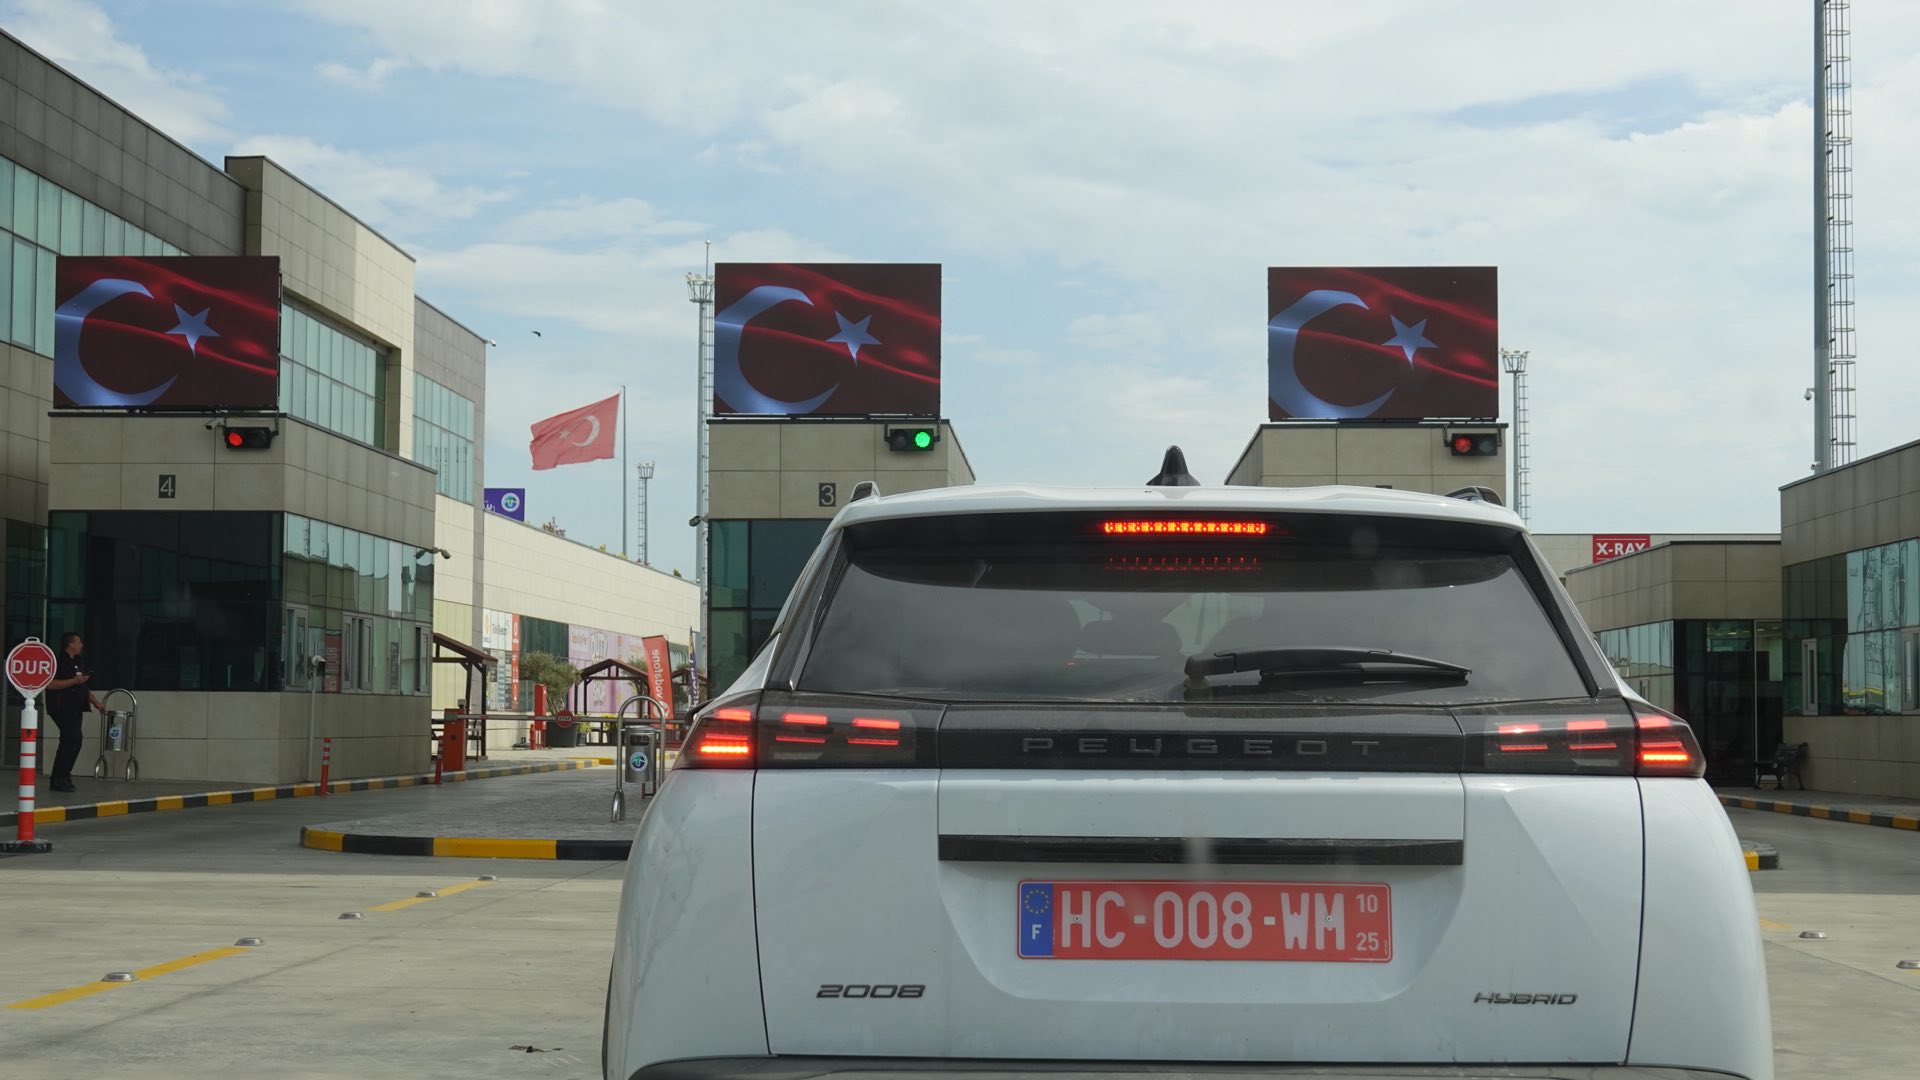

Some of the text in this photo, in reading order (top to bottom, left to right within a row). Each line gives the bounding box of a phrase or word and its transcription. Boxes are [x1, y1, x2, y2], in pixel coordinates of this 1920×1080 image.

[160, 476, 174, 497] 4
[821, 484, 835, 506] 3
[1595, 542, 1646, 556] X-RAY
[11, 659, 51, 675] DUR
[1023, 737, 1380, 757] PEUGEOT
[1356, 893, 1378, 913] 10
[1061, 890, 1346, 950] HC-008-WM
[1031, 924, 1042, 940] F
[1356, 932, 1379, 951] 25
[816, 984, 926, 999] 2008
[1473, 991, 1578, 1005] HYBRID
